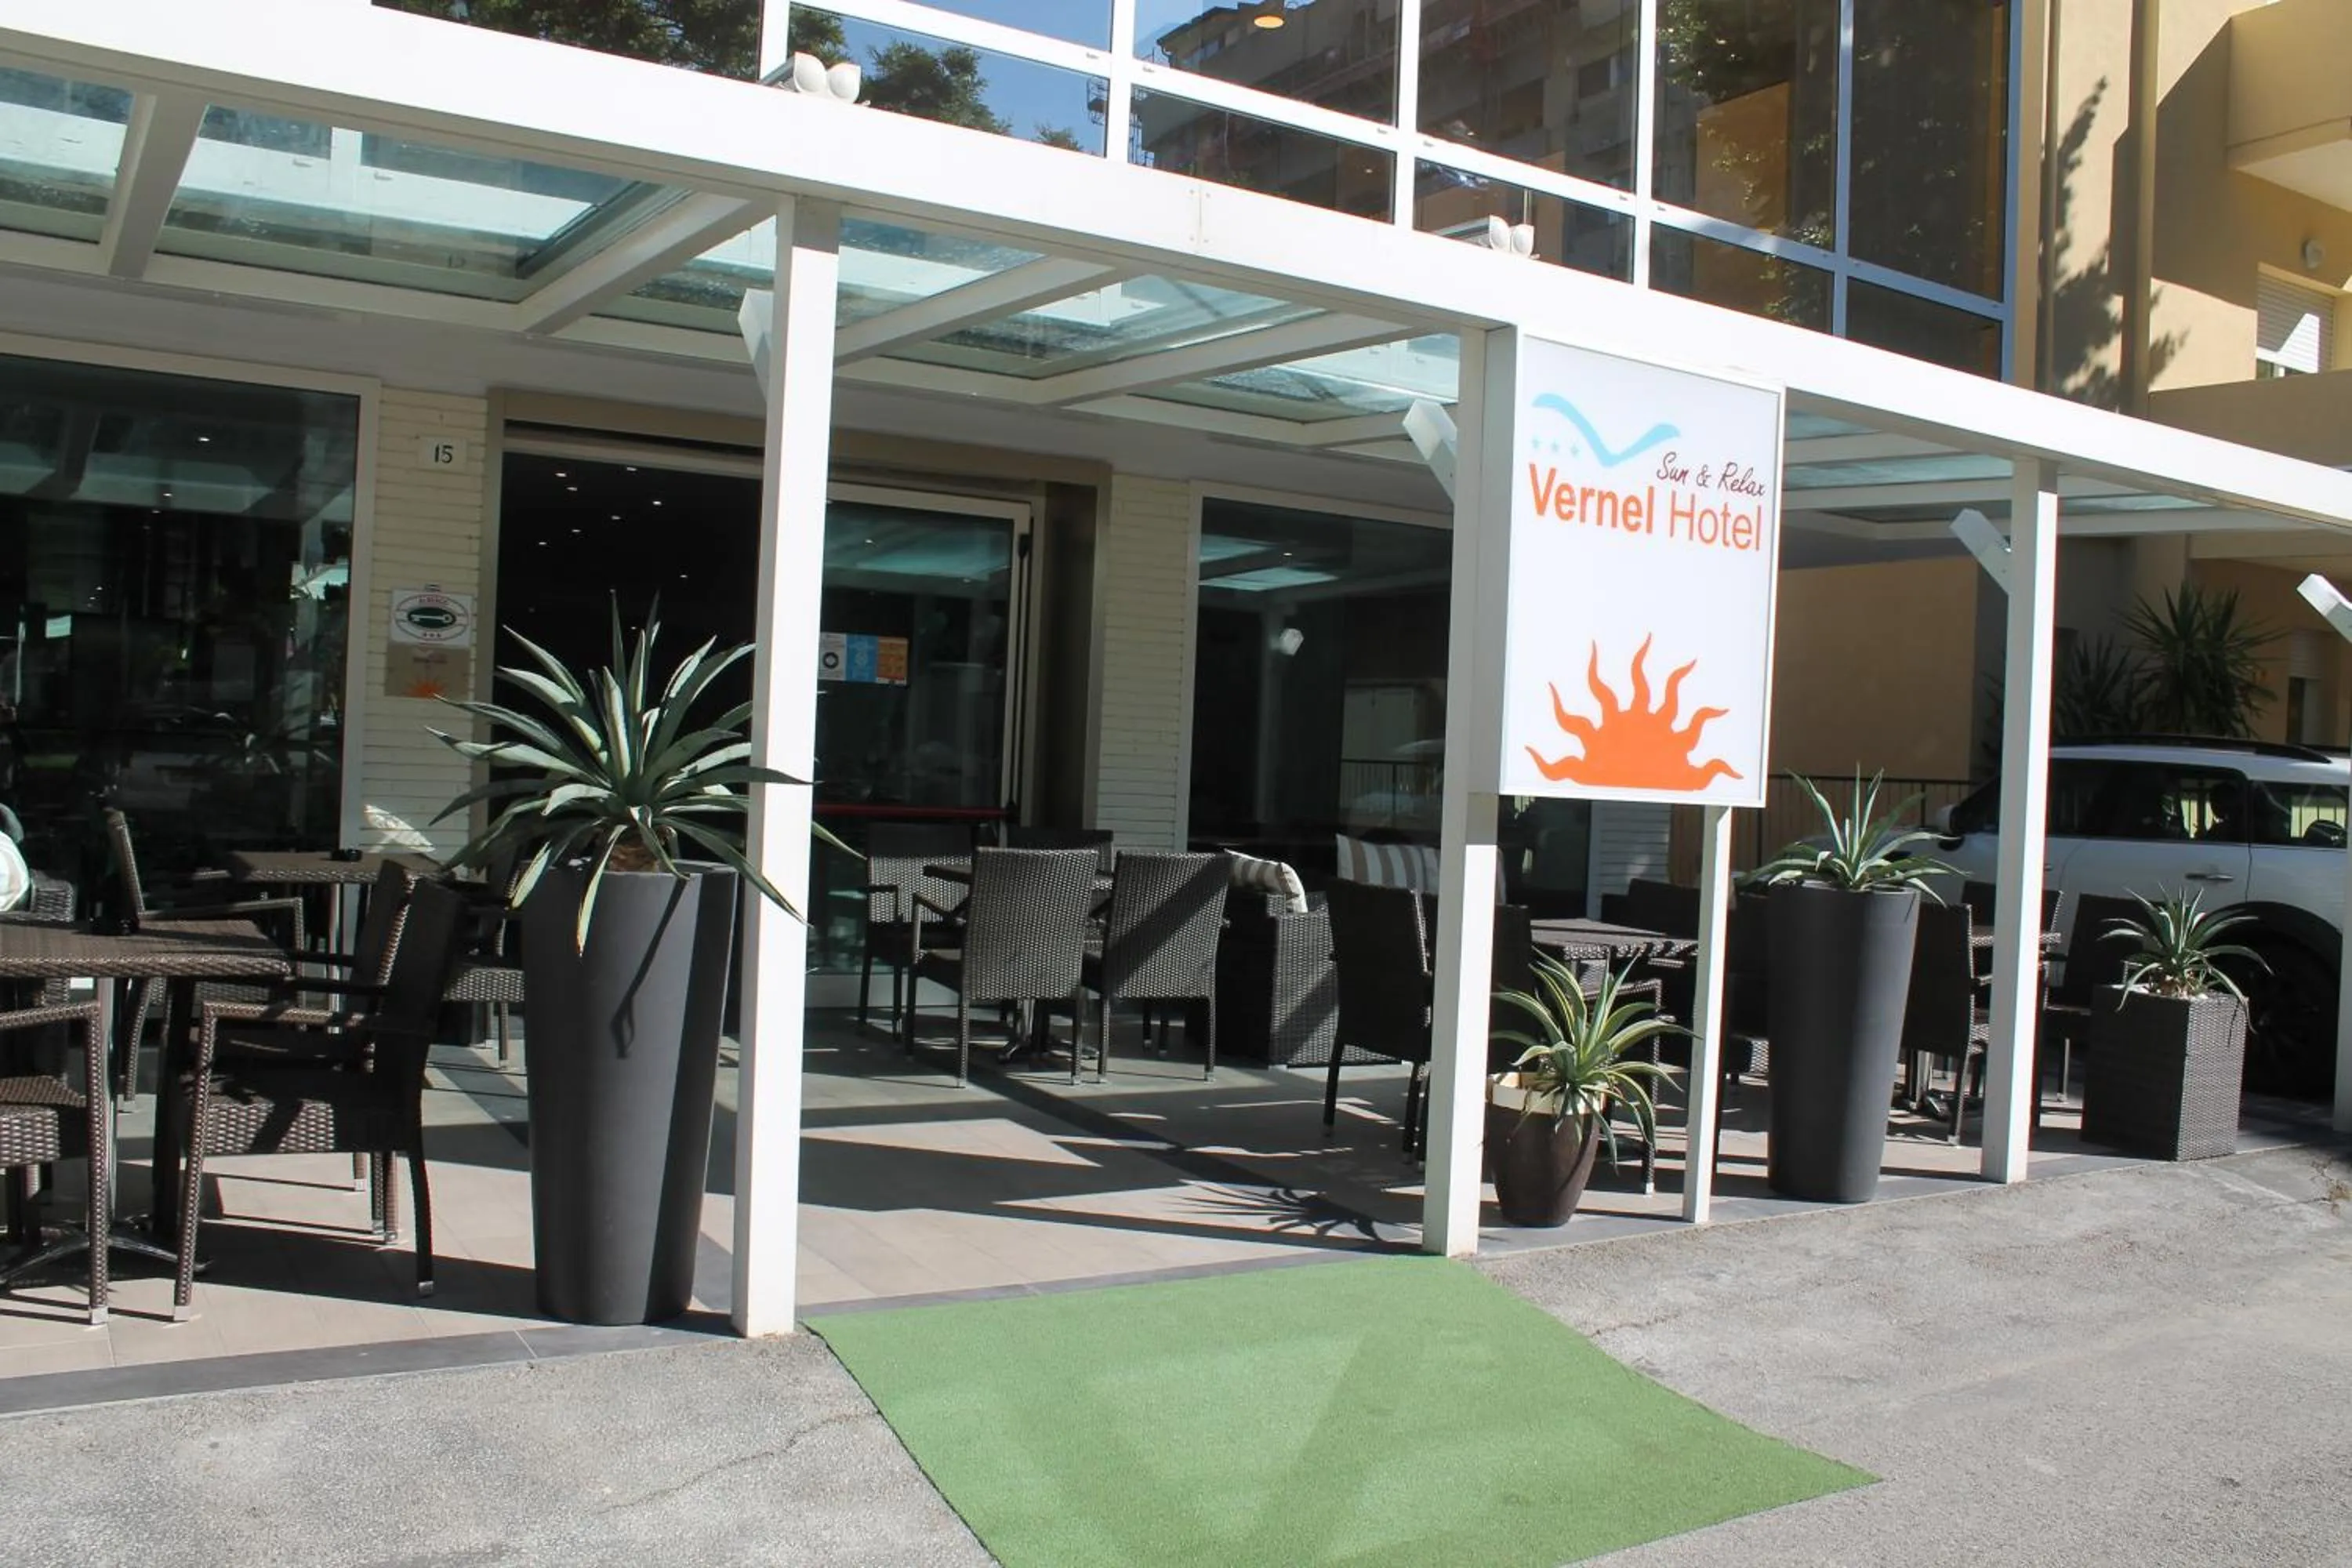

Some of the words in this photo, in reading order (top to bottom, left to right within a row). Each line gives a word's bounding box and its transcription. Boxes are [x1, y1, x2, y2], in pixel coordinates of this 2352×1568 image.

[434, 444, 453, 463] 15
[1656, 451, 1690, 485] Sun
[1696, 464, 1713, 489] &
[1717, 461, 1766, 498] Relax
[1529, 463, 1655, 535] Vernel
[1669, 489, 1762, 552] Hotel
